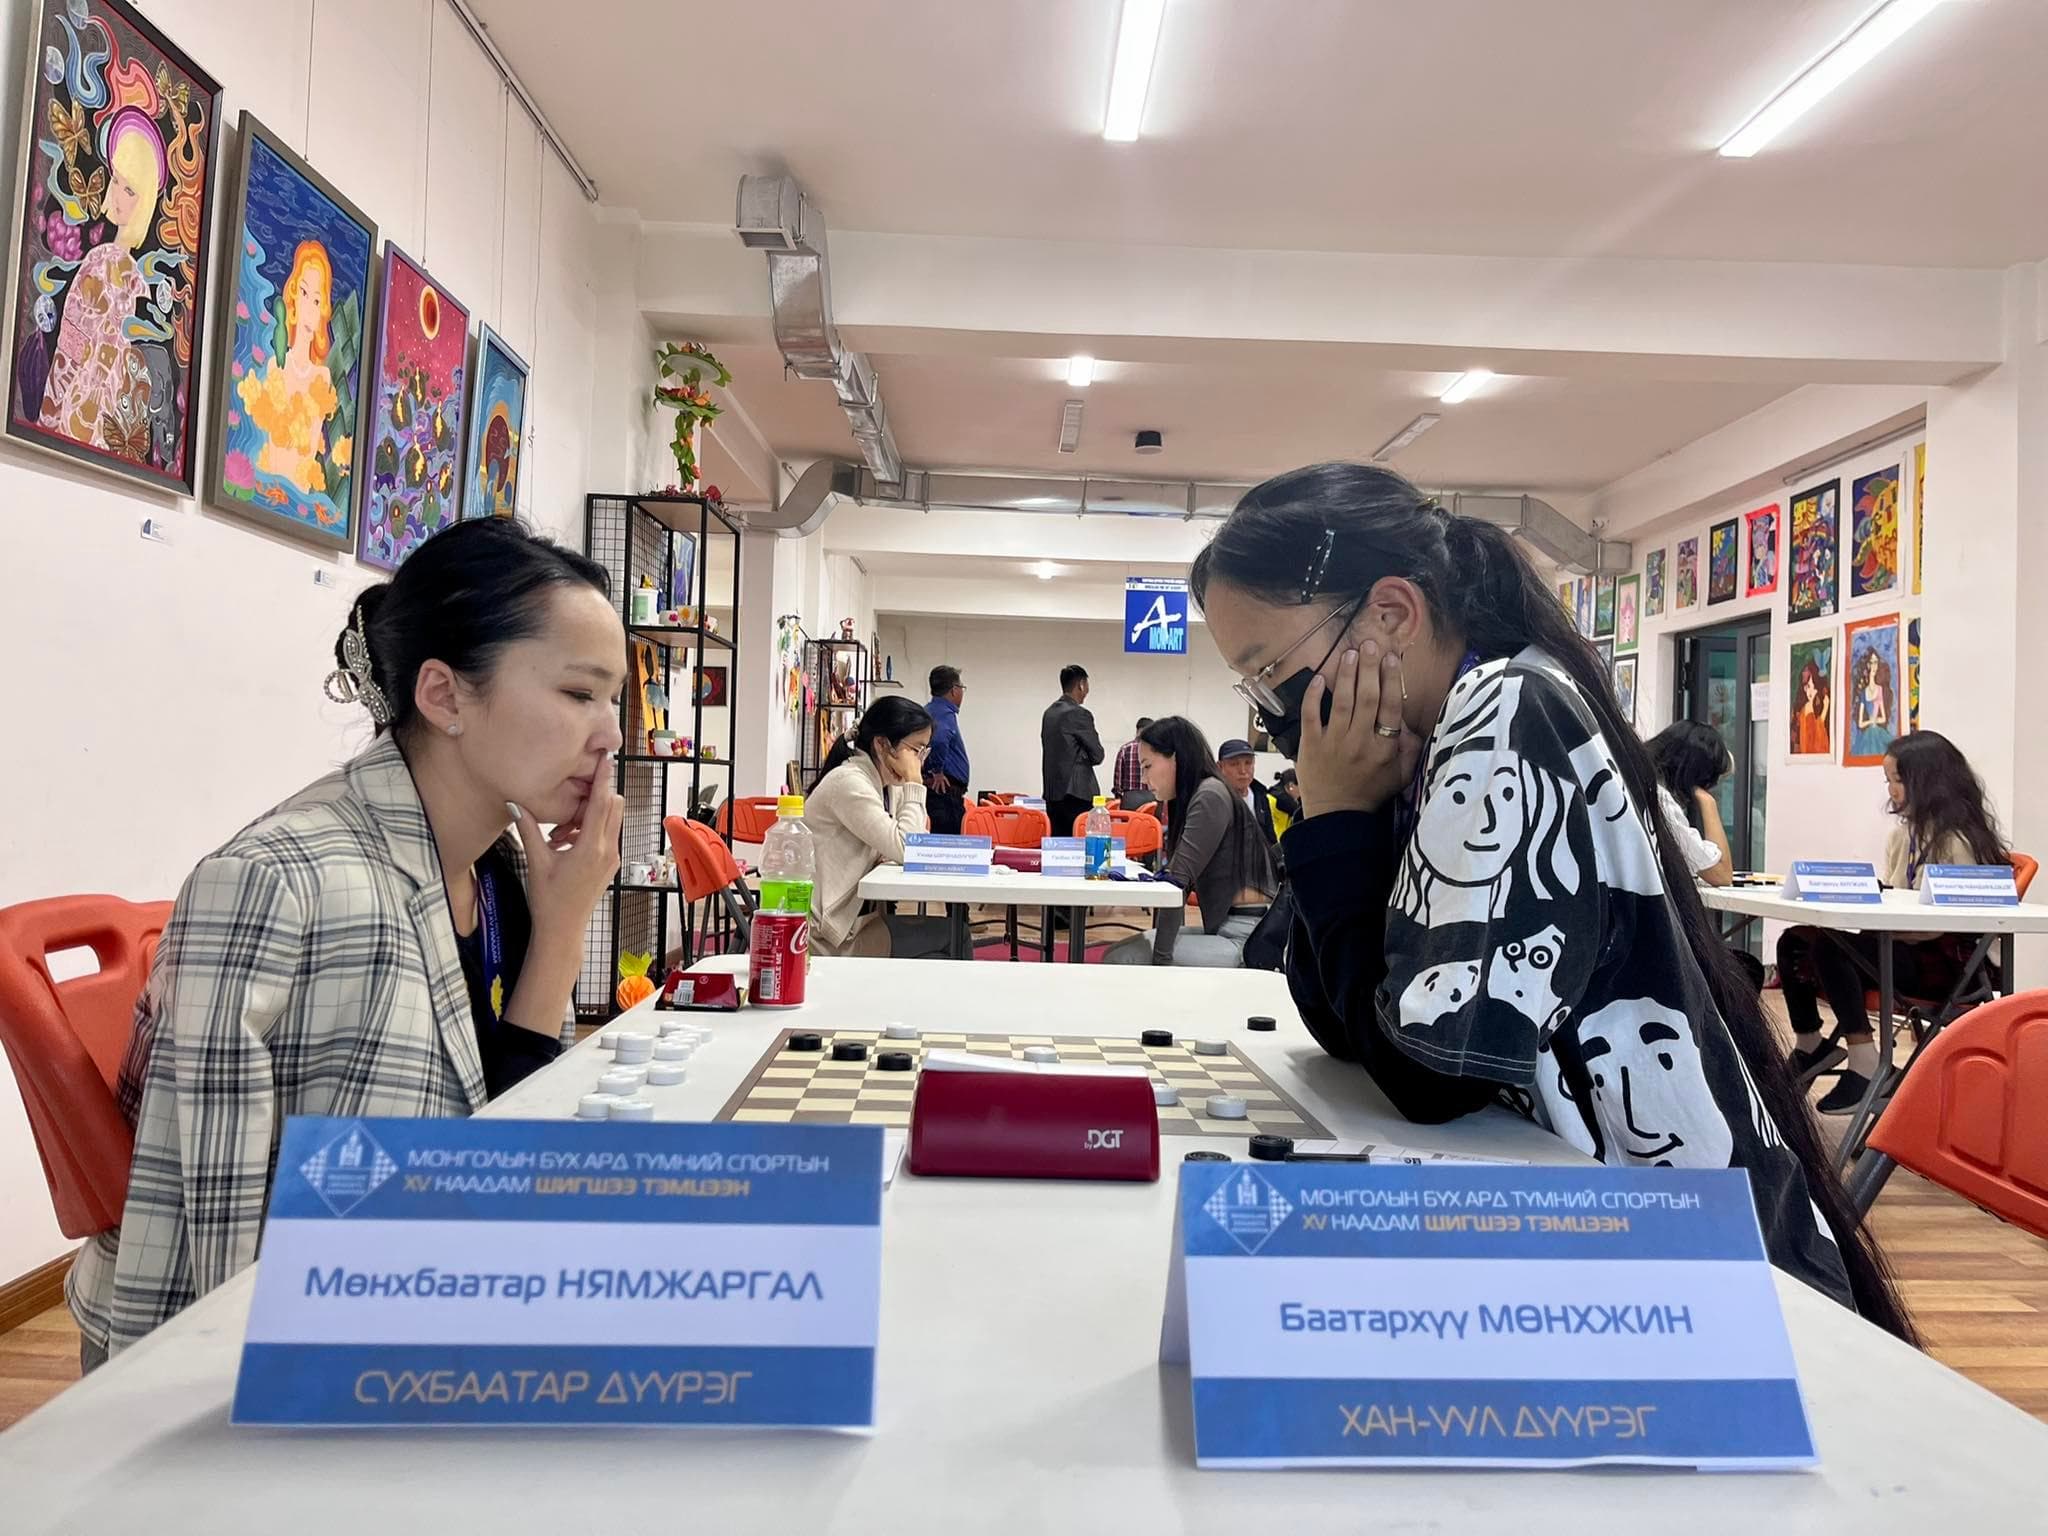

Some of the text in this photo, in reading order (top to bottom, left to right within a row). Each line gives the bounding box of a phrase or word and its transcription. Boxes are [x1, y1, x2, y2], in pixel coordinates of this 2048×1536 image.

[1087, 1129, 1124, 1149] DGT
[407, 1150, 831, 1173] МОНГОЛЫН БҮХ АРД ТҮМНИЙ СПОРТЫН
[403, 1174, 751, 1197] XV НААДАМ ШИГШЭЭ ТЭМЦЭЭН
[1300, 1188, 1700, 1210] МОНГОЛЫН БҮХ АРД ТҮМНИЙ СПОРТЫН
[1302, 1213, 1631, 1233] XV НААДАМ ШИГШЭЭ ТЭМЦЭЭН
[304, 1265, 826, 1305] Мөнхбаатар НЯМЖАРГАЛ
[1279, 1302, 1694, 1340] Баатархүү МӨНХЖИН
[595, 1371, 754, 1405] ДҮҮРЭГ
[1511, 1405, 1659, 1439] ДҮҮРЭГ
